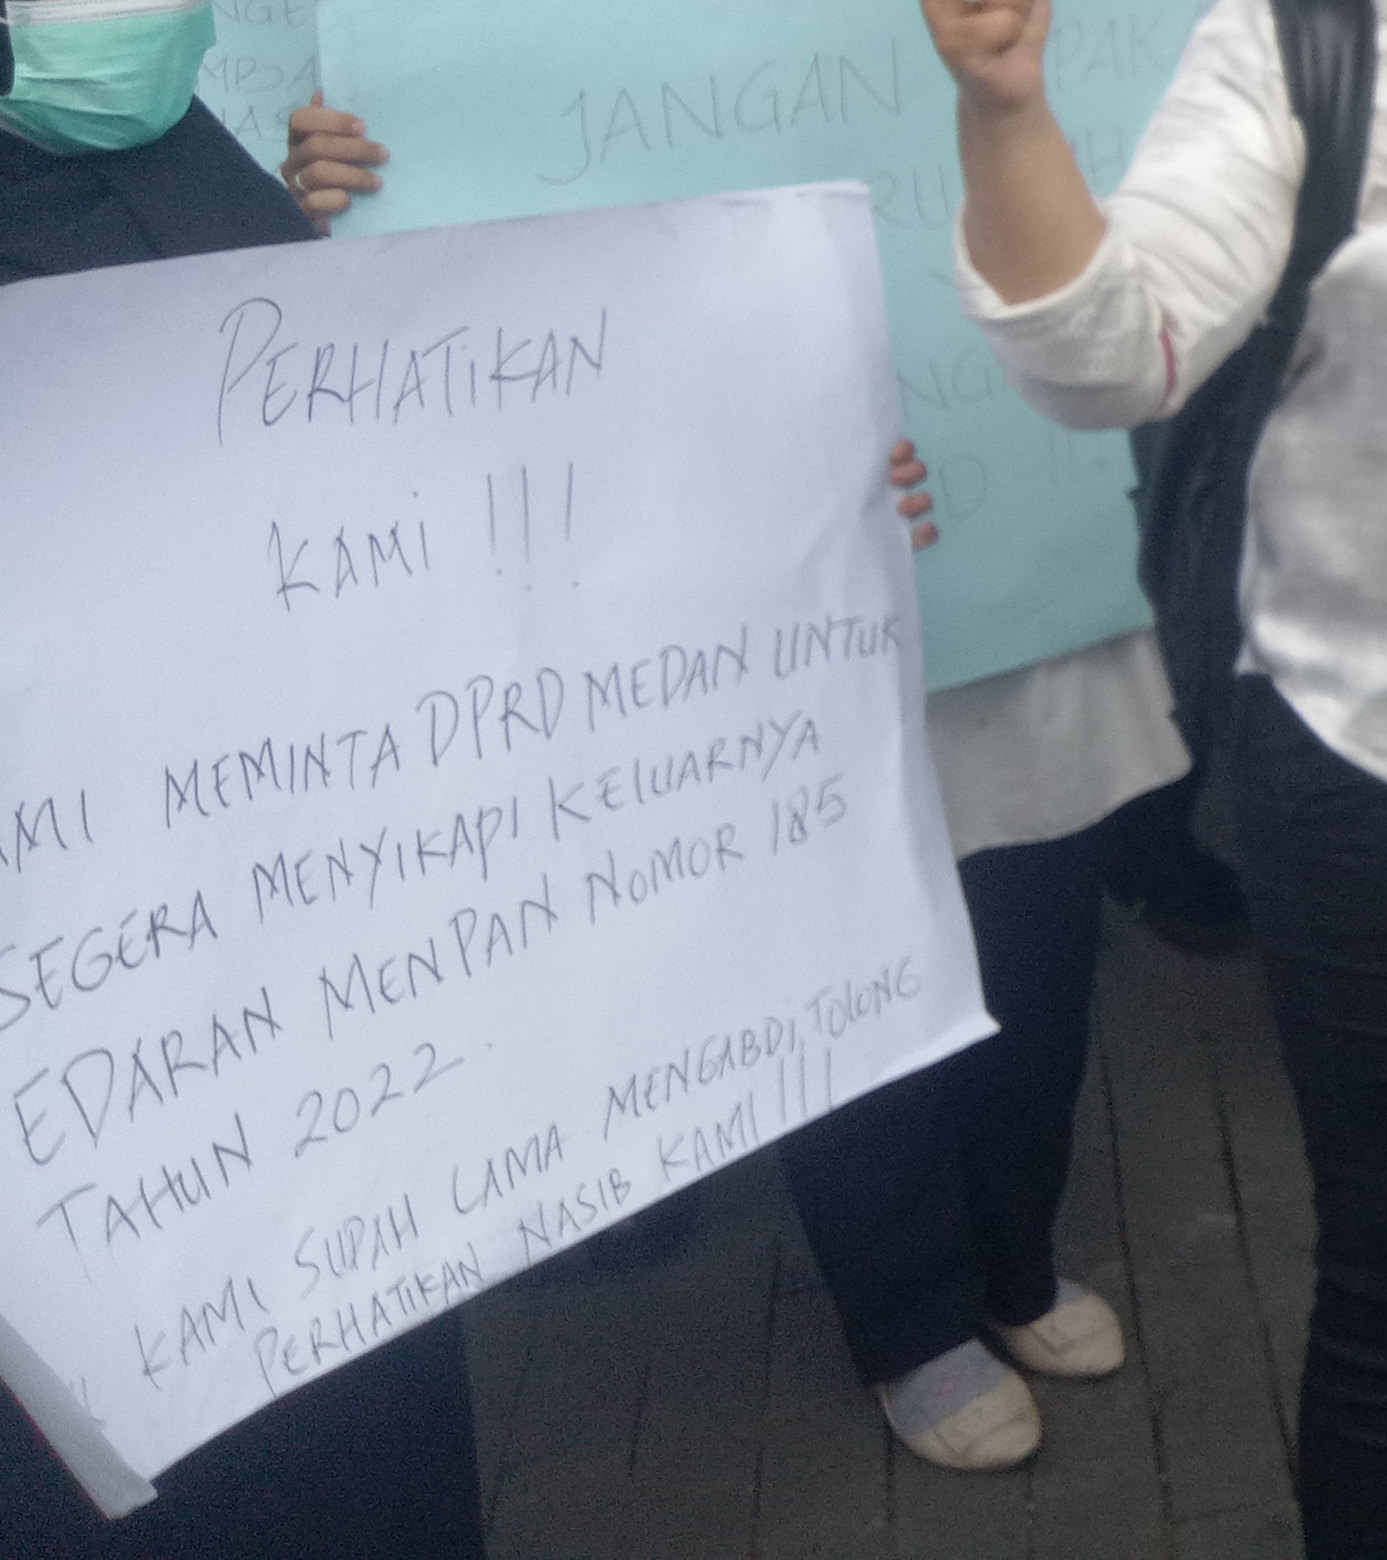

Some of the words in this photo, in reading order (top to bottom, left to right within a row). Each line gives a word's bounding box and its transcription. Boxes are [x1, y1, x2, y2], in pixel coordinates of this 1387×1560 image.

[537, 38, 902, 185] JANGAN
[487, 460, 580, 593] !!!
[0, 788, 94, 874] MI
[164, 725, 402, 829] MEMINTA
[416, 666, 566, 768] DPRD
[585, 624, 750, 734] MEDAN
[772, 611, 903, 683] UNTUK
[0, 889, 218, 1032] SEGERA
[252, 806, 522, 925] MENYIKAPI
[13, 984, 284, 1167] EDARAN
[318, 873, 560, 1040] MENPAN
[34, 1112, 254, 1285] TAHUN
[133, 1275, 268, 1391] KAMI
[452, 1121, 566, 1216] LAMA
[252, 1241, 484, 1398] PERHATIKAN
[518, 1167, 632, 1266] NASIB
[656, 1092, 761, 1183] KAMI
